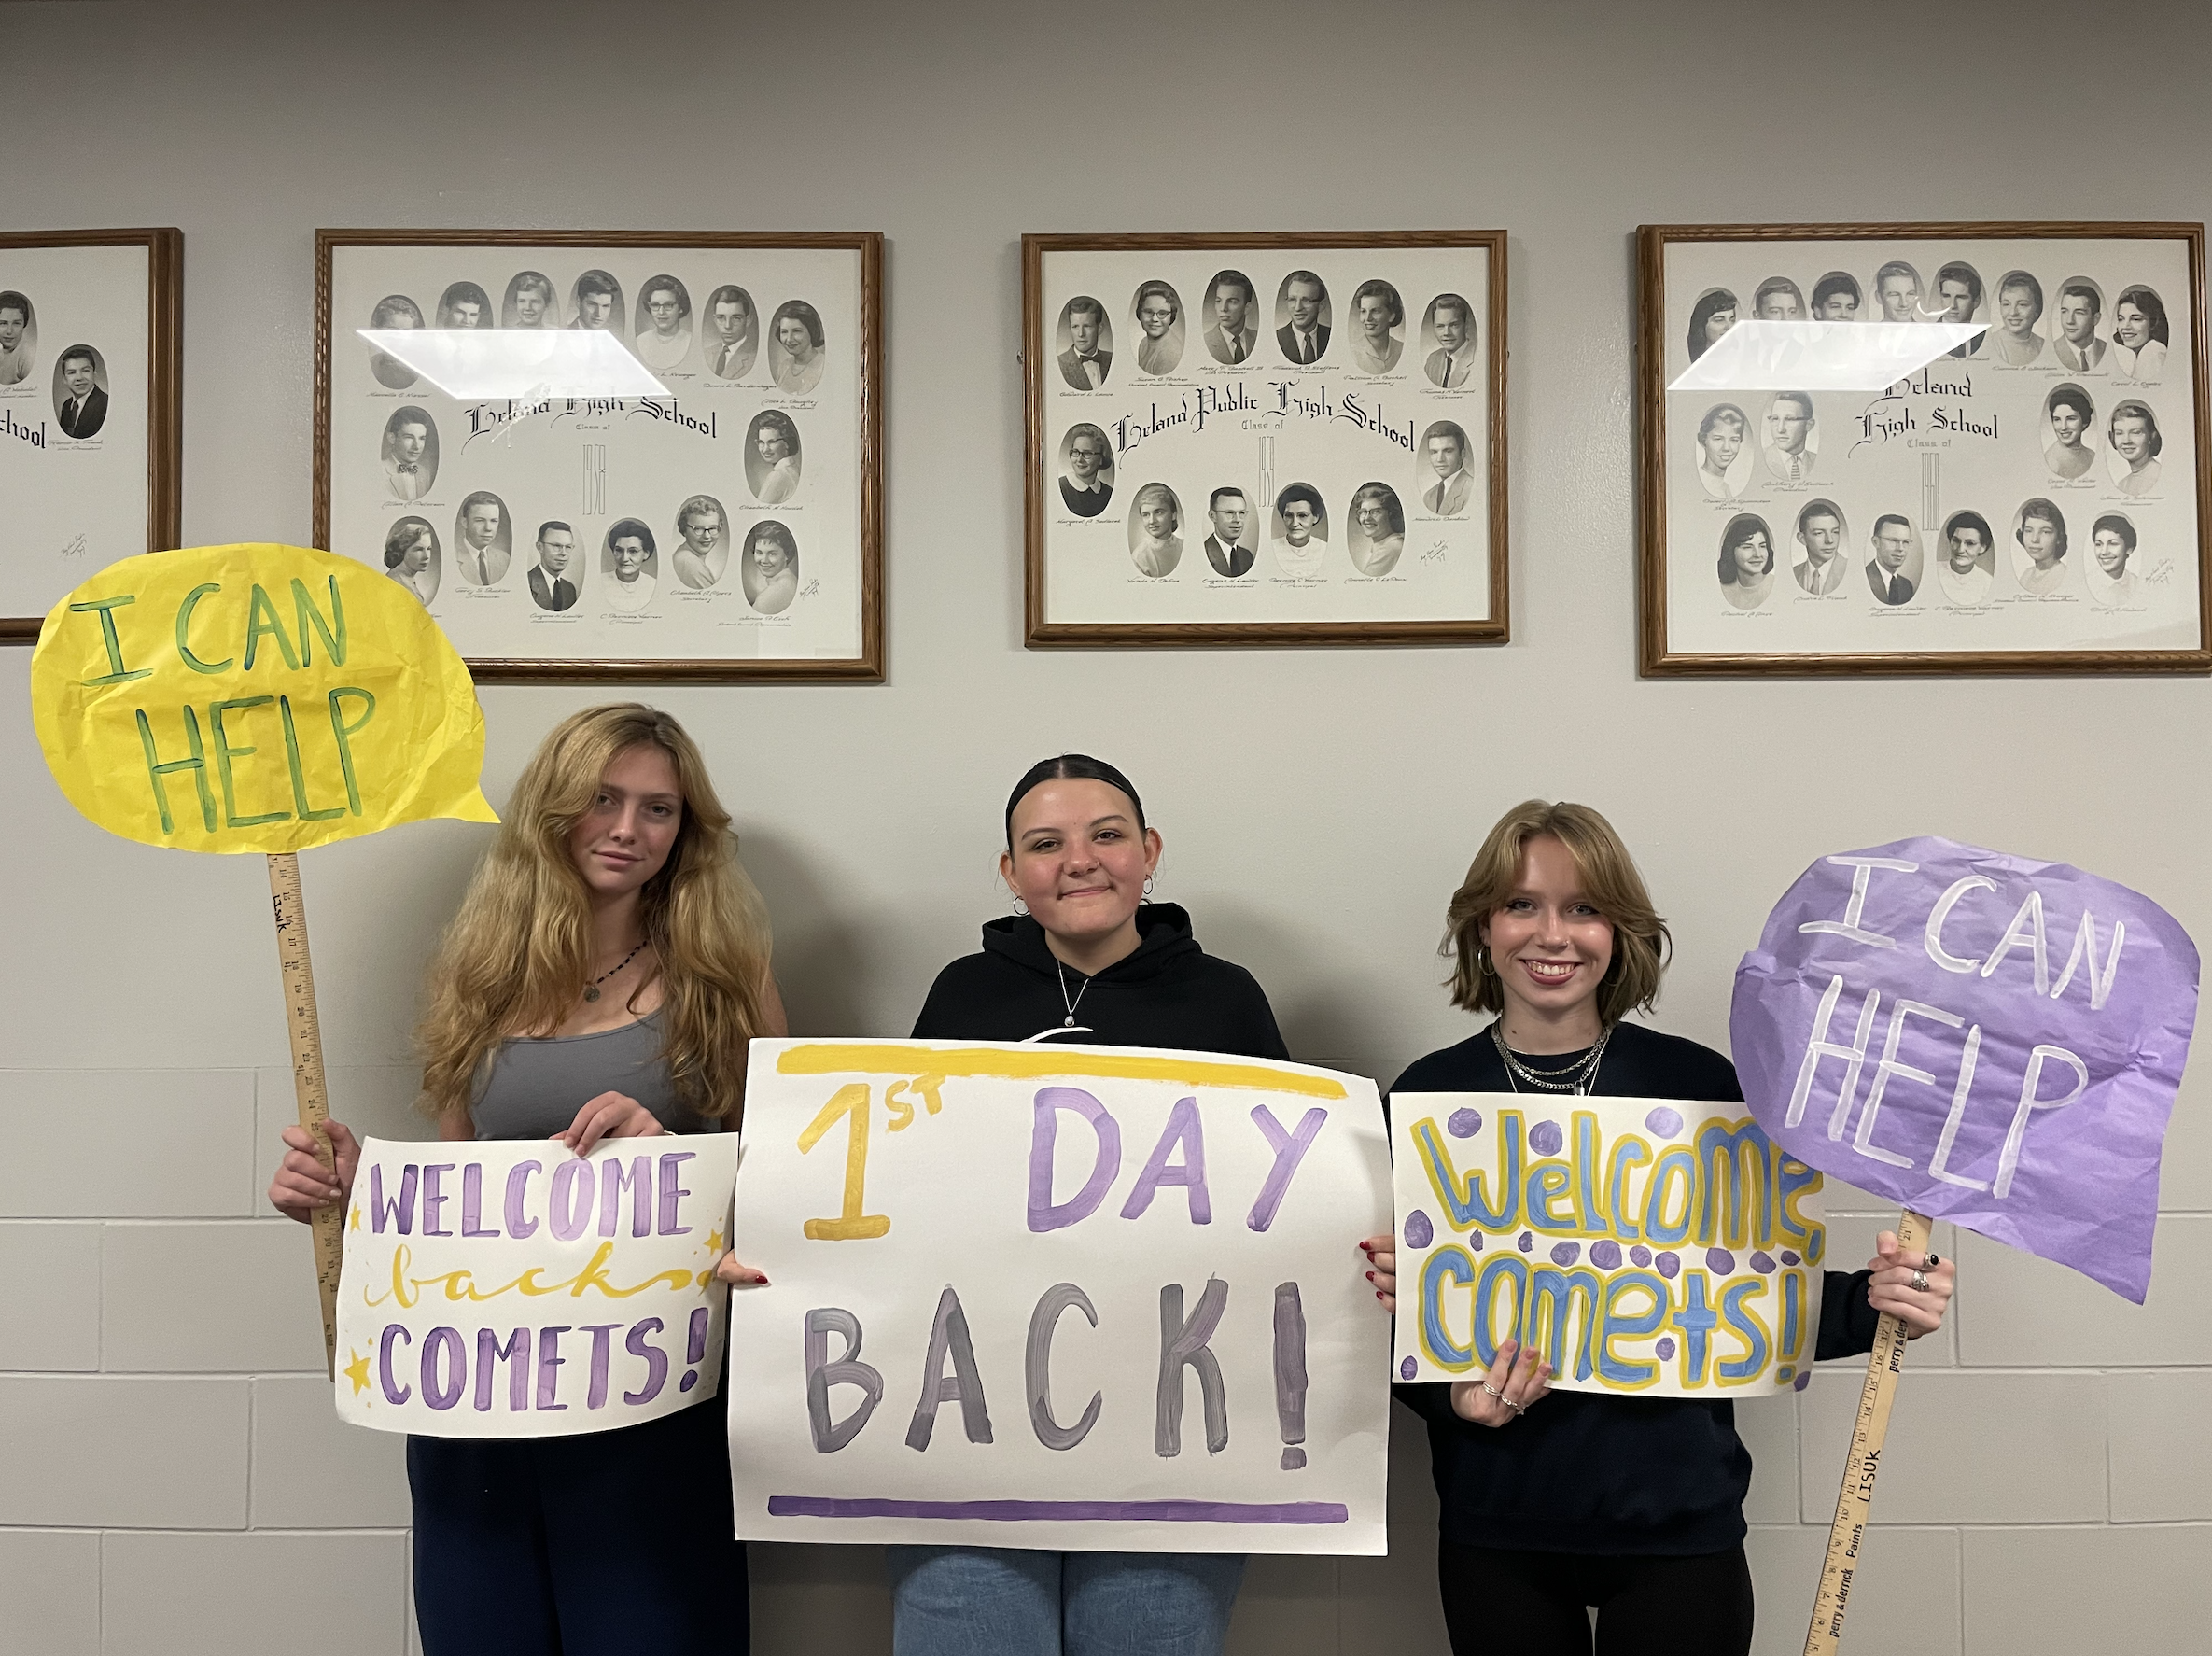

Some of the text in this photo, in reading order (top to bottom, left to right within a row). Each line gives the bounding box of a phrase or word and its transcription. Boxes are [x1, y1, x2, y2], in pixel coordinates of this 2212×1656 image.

[626, 396, 717, 439] School
[1190, 382, 1260, 434] Public
[1262, 378, 1333, 420] High
[1330, 392, 1415, 453] School
[1241, 420, 1284, 430] Class of
[1926, 405, 1998, 439] School
[0, 409, 46, 449] chool
[1907, 439, 1952, 448] Class of
[70, 574, 347, 686] I CAN
[136, 687, 375, 835] HELP
[288, 937, 297, 947] 17
[1798, 855, 2126, 1011] I CAN
[294, 984, 302, 993] 19
[300, 1030, 308, 1039] 21
[302, 1053, 311, 1062] 22
[1785, 975, 2089, 1199] HELP
[1027, 1087, 1328, 1232] DAY
[371, 1152, 696, 1242] WELCOME
[1882, 1329, 1889, 1341] 17
[1896, 1337, 1905, 1346] &
[379, 1307, 709, 1411] COMETS!
[1875, 1354, 1883, 1367] 16
[1889, 1346, 1904, 1373] perry
[805, 1271, 1309, 1470] BACK!
[1869, 1381, 1878, 1392] 15
[1864, 1406, 1872, 1417] 14
[1858, 1433, 1867, 1444] 13
[1853, 1458, 1860, 1469] 12
[1857, 1449, 1881, 1503] LISUK
[1847, 1485, 1855, 1495] 11
[1841, 1509, 1849, 1521] 10
[1829, 1523, 1863, 1638] perry & derrick Paints
